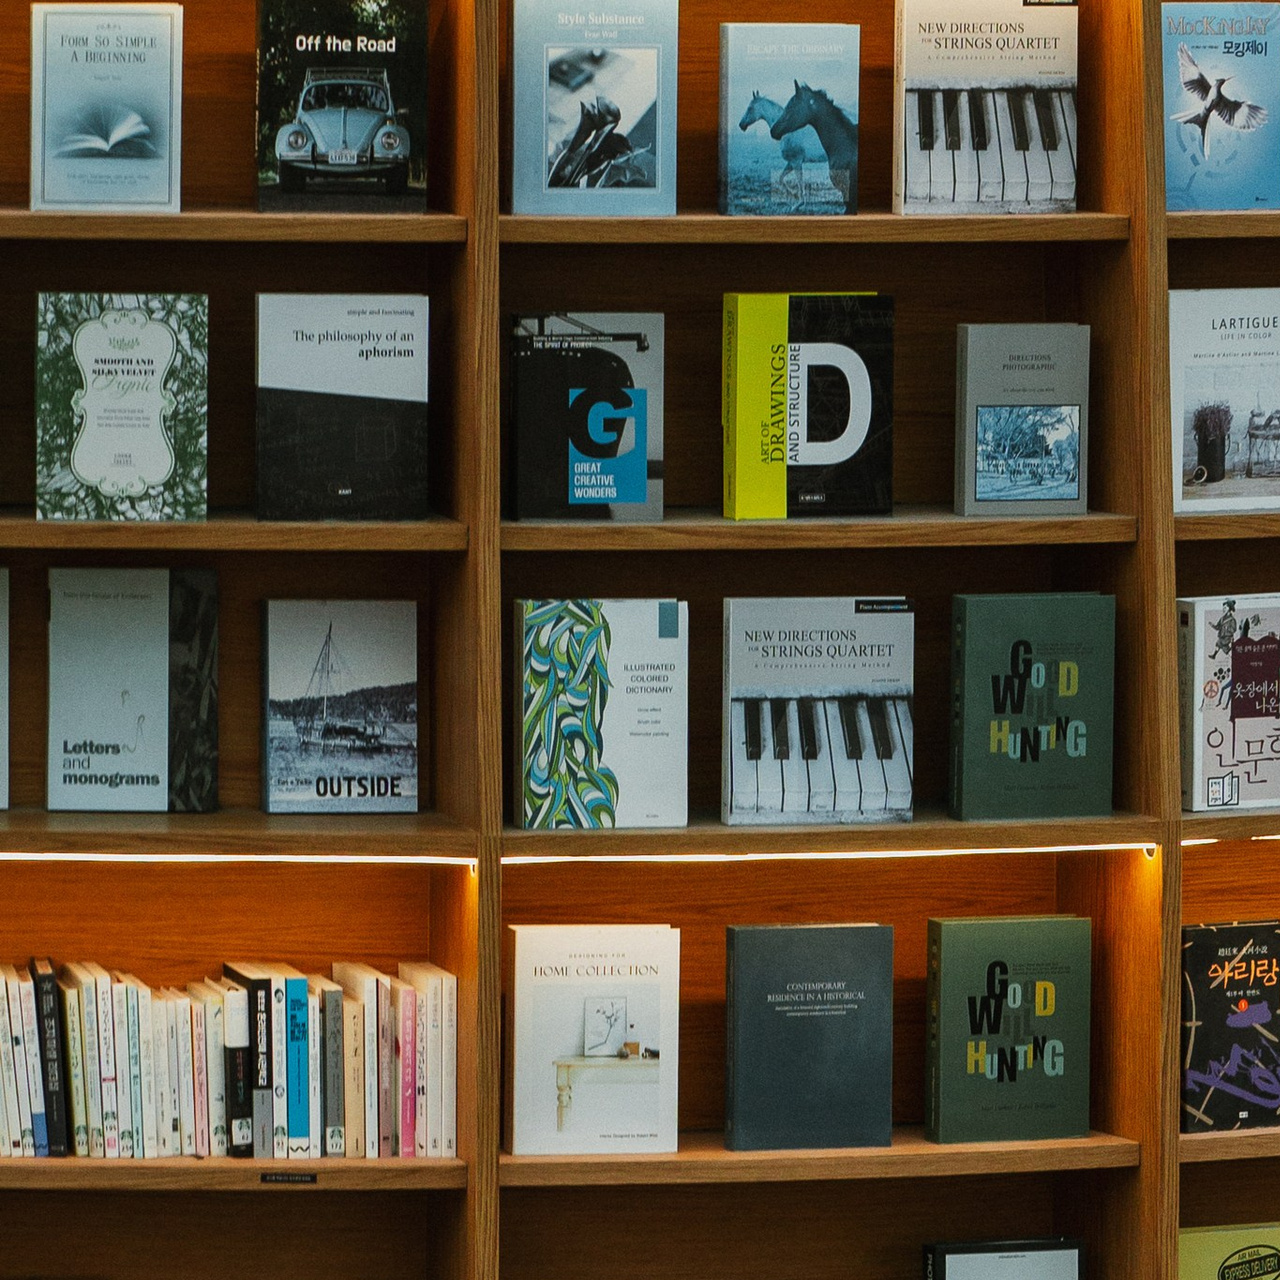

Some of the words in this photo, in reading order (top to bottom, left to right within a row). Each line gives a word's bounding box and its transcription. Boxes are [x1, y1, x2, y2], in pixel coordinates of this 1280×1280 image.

[918, 23, 947, 34] NEW
[950, 22, 1024, 34] DIRECTIONS
[295, 35, 321, 52] Off
[326, 35, 352, 52] the
[357, 35, 396, 53] Road
[934, 38, 992, 51] STRINGS
[996, 36, 1060, 51] QUARTET
[1222, 40, 1268, 57] 모킹제이
[1211, 316, 1279, 330] LARTIGUE
[293, 330, 314, 342] The
[318, 330, 382, 347] philosophy
[386, 330, 398, 342] of
[400, 333, 414, 342] an
[358, 346, 415, 361] aphorism
[788, 344, 800, 435] STRUCTURE
[770, 343, 786, 464] DRAWINGS
[761, 421, 769, 438] OF
[761, 441, 769, 464] ART
[788, 440, 799, 462] AND
[574, 462, 601, 474] GREAT
[574, 475, 615, 487] CREATIVE
[574, 487, 617, 499] WONDERS
[744, 630, 775, 642] NEW
[778, 630, 857, 642] DIRECTIONS
[761, 645, 824, 658] STRINGS
[827, 644, 894, 659] QUARTET
[623, 664, 676, 672] ILLUSTRATED
[630, 675, 669, 683] COLORED
[626, 686, 673, 694] DICTIONARY
[63, 740, 120, 755] Letters
[63, 756, 90, 770] and
[63, 773, 160, 788] monograms
[316, 776, 401, 797] OUTSIDE
[534, 965, 571, 977] HOME
[576, 965, 659, 976] COLLECTION
[1208, 957, 1280, 988] 아리랑
[787, 981, 846, 991] CONTEMPORARY
